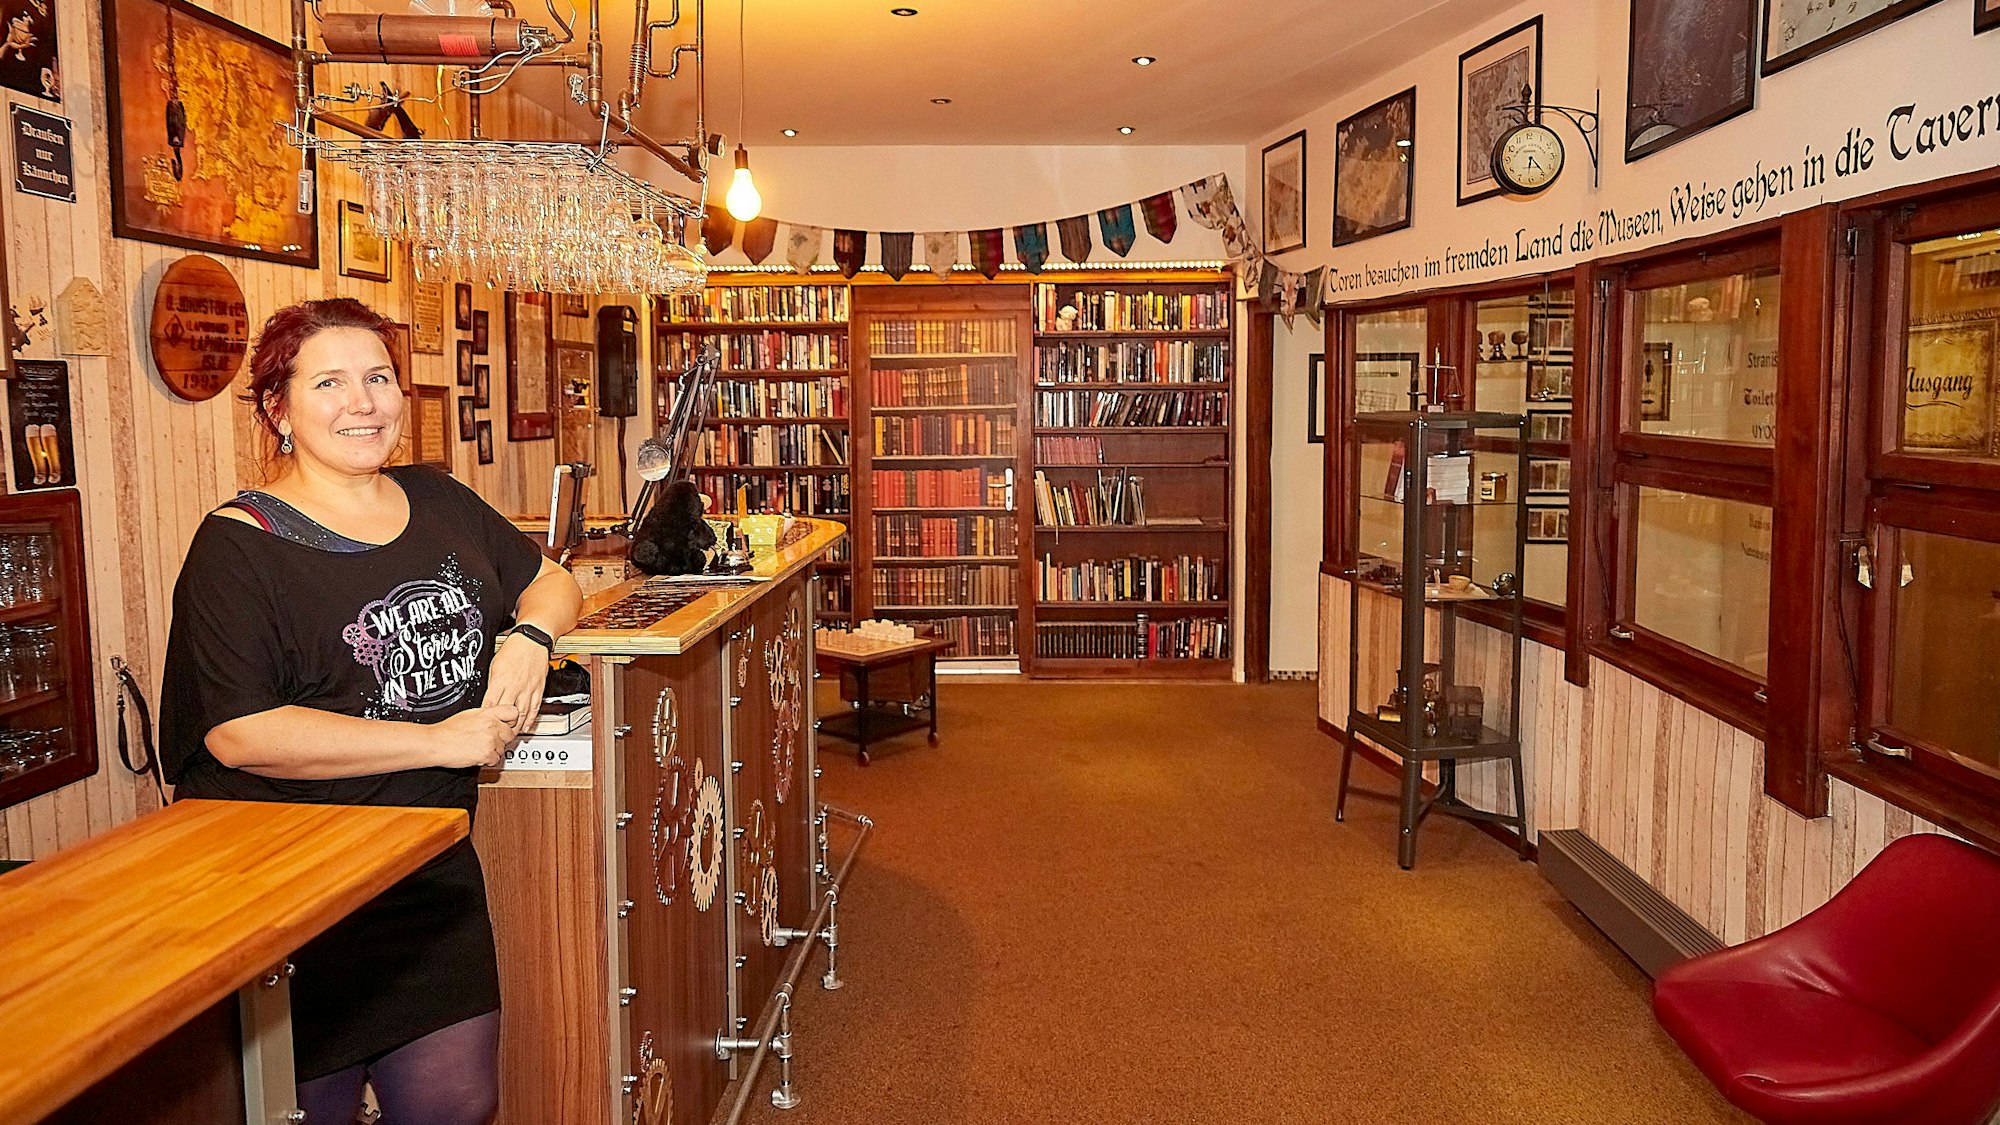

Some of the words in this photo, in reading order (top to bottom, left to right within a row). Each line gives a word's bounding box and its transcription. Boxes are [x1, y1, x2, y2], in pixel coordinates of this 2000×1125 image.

[20, 120, 65, 146] Draußen
[35, 148, 54, 162] nur
[1329, 267, 1362, 293] Toren
[1365, 259, 1420, 287] besuchen
[1424, 256, 1441, 277] im
[1445, 238, 1509, 274] fremden
[1515, 228, 1563, 263] Land
[1568, 220, 1594, 254] die
[1597, 207, 1665, 247] Museen,
[1669, 181, 1727, 227] Weise
[1731, 158, 1795, 219] gehen
[1802, 143, 1826, 190] in
[1834, 126, 1876, 178] die
[1905, 365, 1974, 401] Ausgang
[370, 605, 405, 637] WE
[407, 596, 441, 626] ARE
[439, 587, 472, 616] ALL
[383, 676, 407, 705] IN
[411, 663, 438, 697] THE
[440, 640, 478, 686] END
[390, 621, 484, 679] Stories
